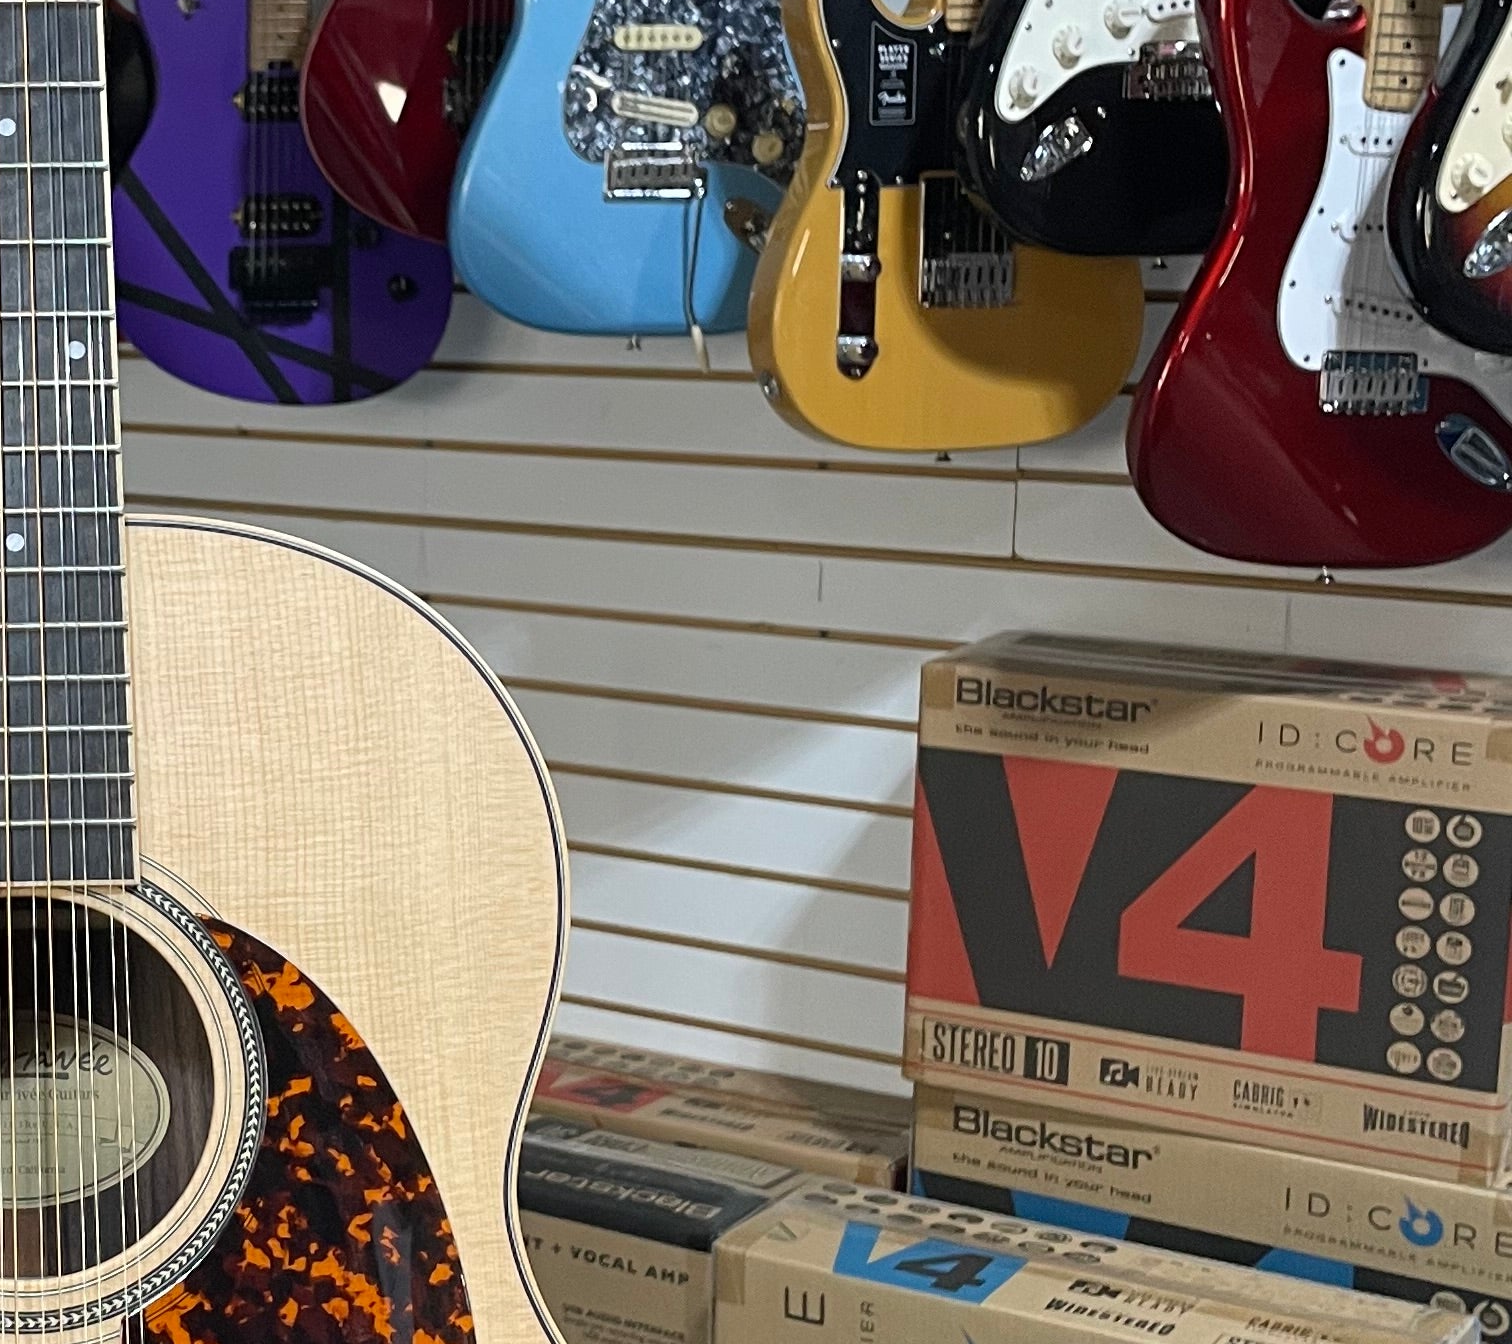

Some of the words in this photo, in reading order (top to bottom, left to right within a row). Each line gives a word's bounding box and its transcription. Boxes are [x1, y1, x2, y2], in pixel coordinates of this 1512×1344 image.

[955, 676, 1152, 724] Blackstar
[932, 1023, 1016, 1074] STEREO
[1034, 1039, 1061, 1082] 10
[952, 1105, 1154, 1170] Blackstar
[570, 1245, 638, 1275] VOCAL
[644, 1264, 691, 1286] AMP
